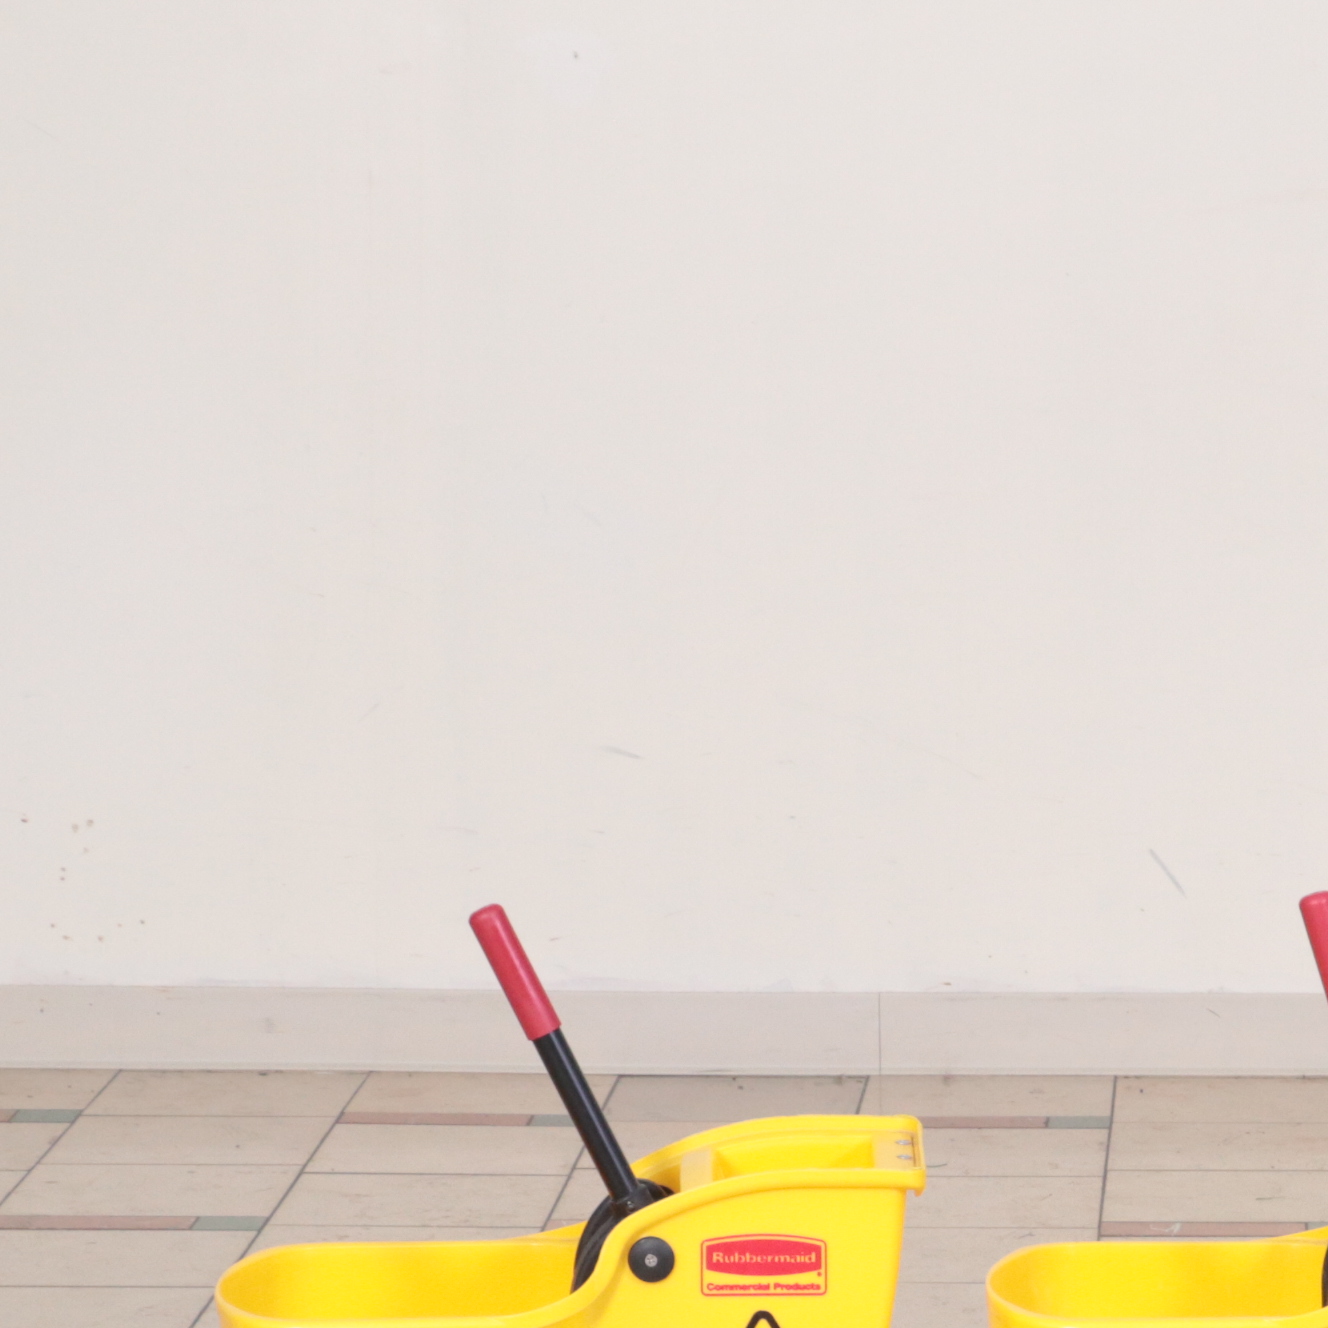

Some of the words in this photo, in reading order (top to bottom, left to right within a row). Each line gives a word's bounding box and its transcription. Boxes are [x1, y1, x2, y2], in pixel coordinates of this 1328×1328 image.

[712, 1251, 817, 1263] Rubbermaid
[706, 1282, 770, 1291] Commercial
[773, 1282, 821, 1291] Products
